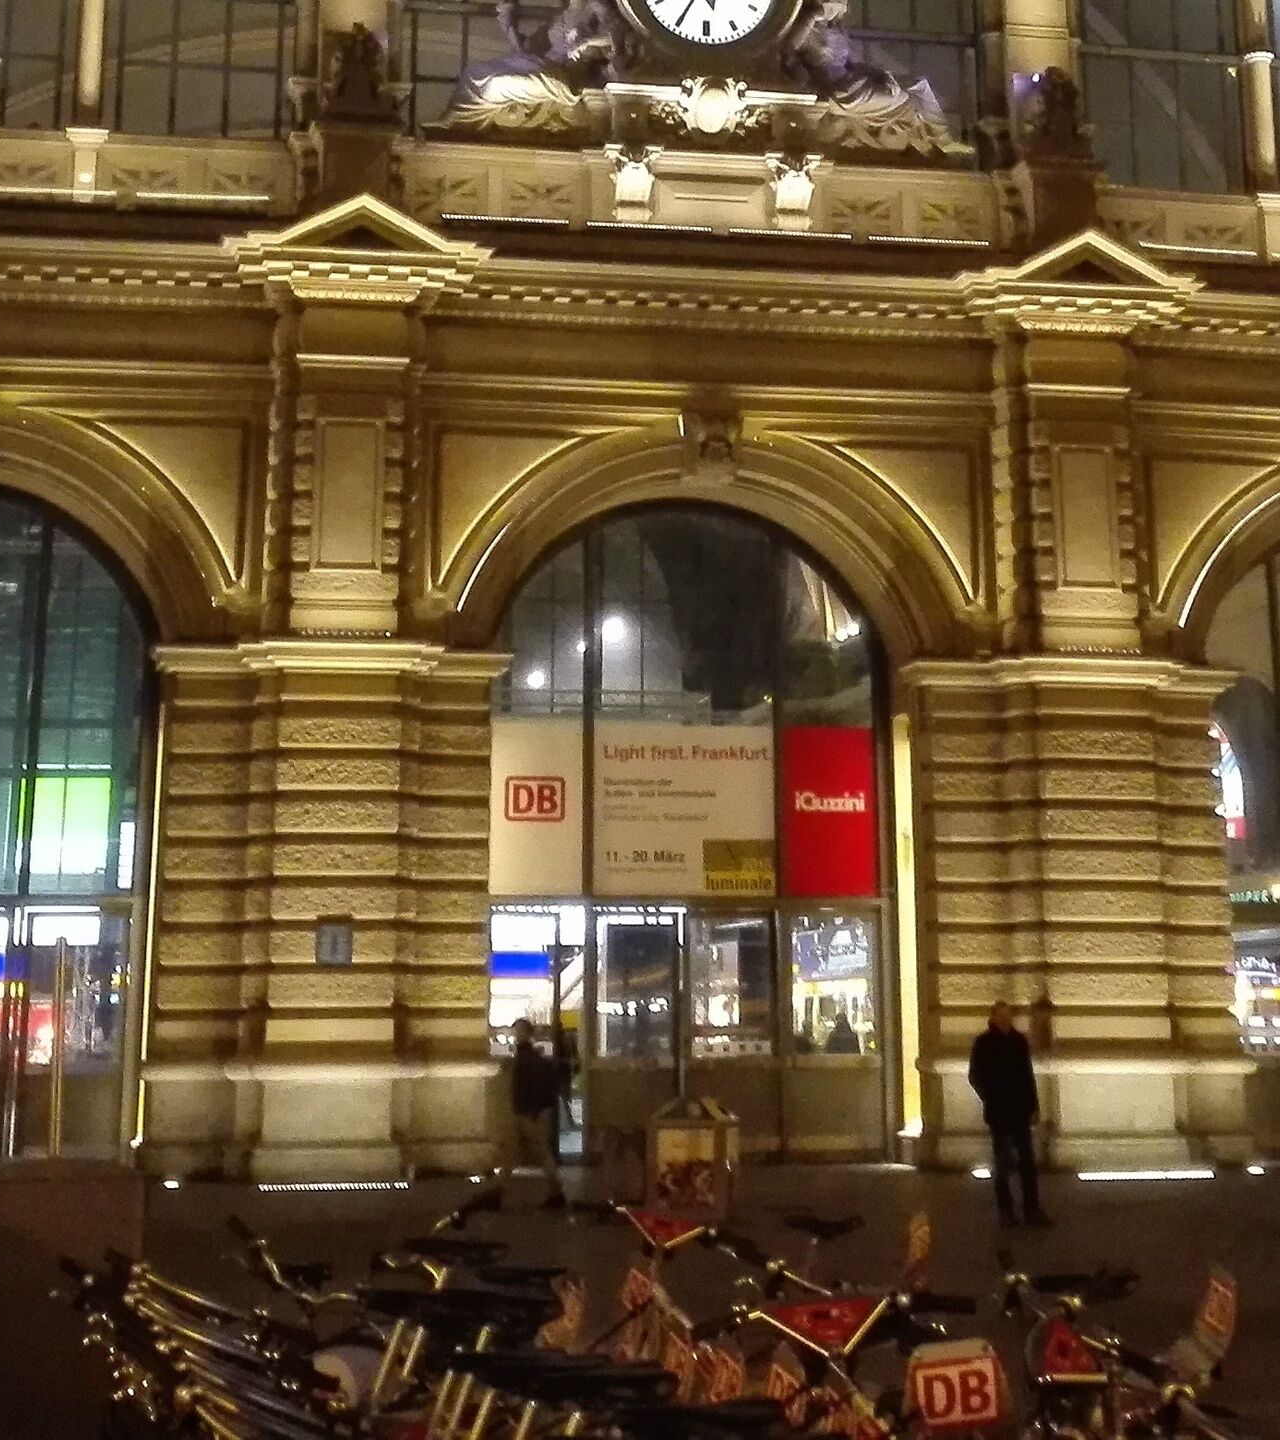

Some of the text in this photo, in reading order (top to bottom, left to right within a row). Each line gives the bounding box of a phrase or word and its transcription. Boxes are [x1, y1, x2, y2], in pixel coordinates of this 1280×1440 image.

[603, 743, 645, 763] Light
[692, 744, 769, 761] Frankfurt
[511, 783, 559, 814] DB
[922, 1368, 992, 1419] DB
